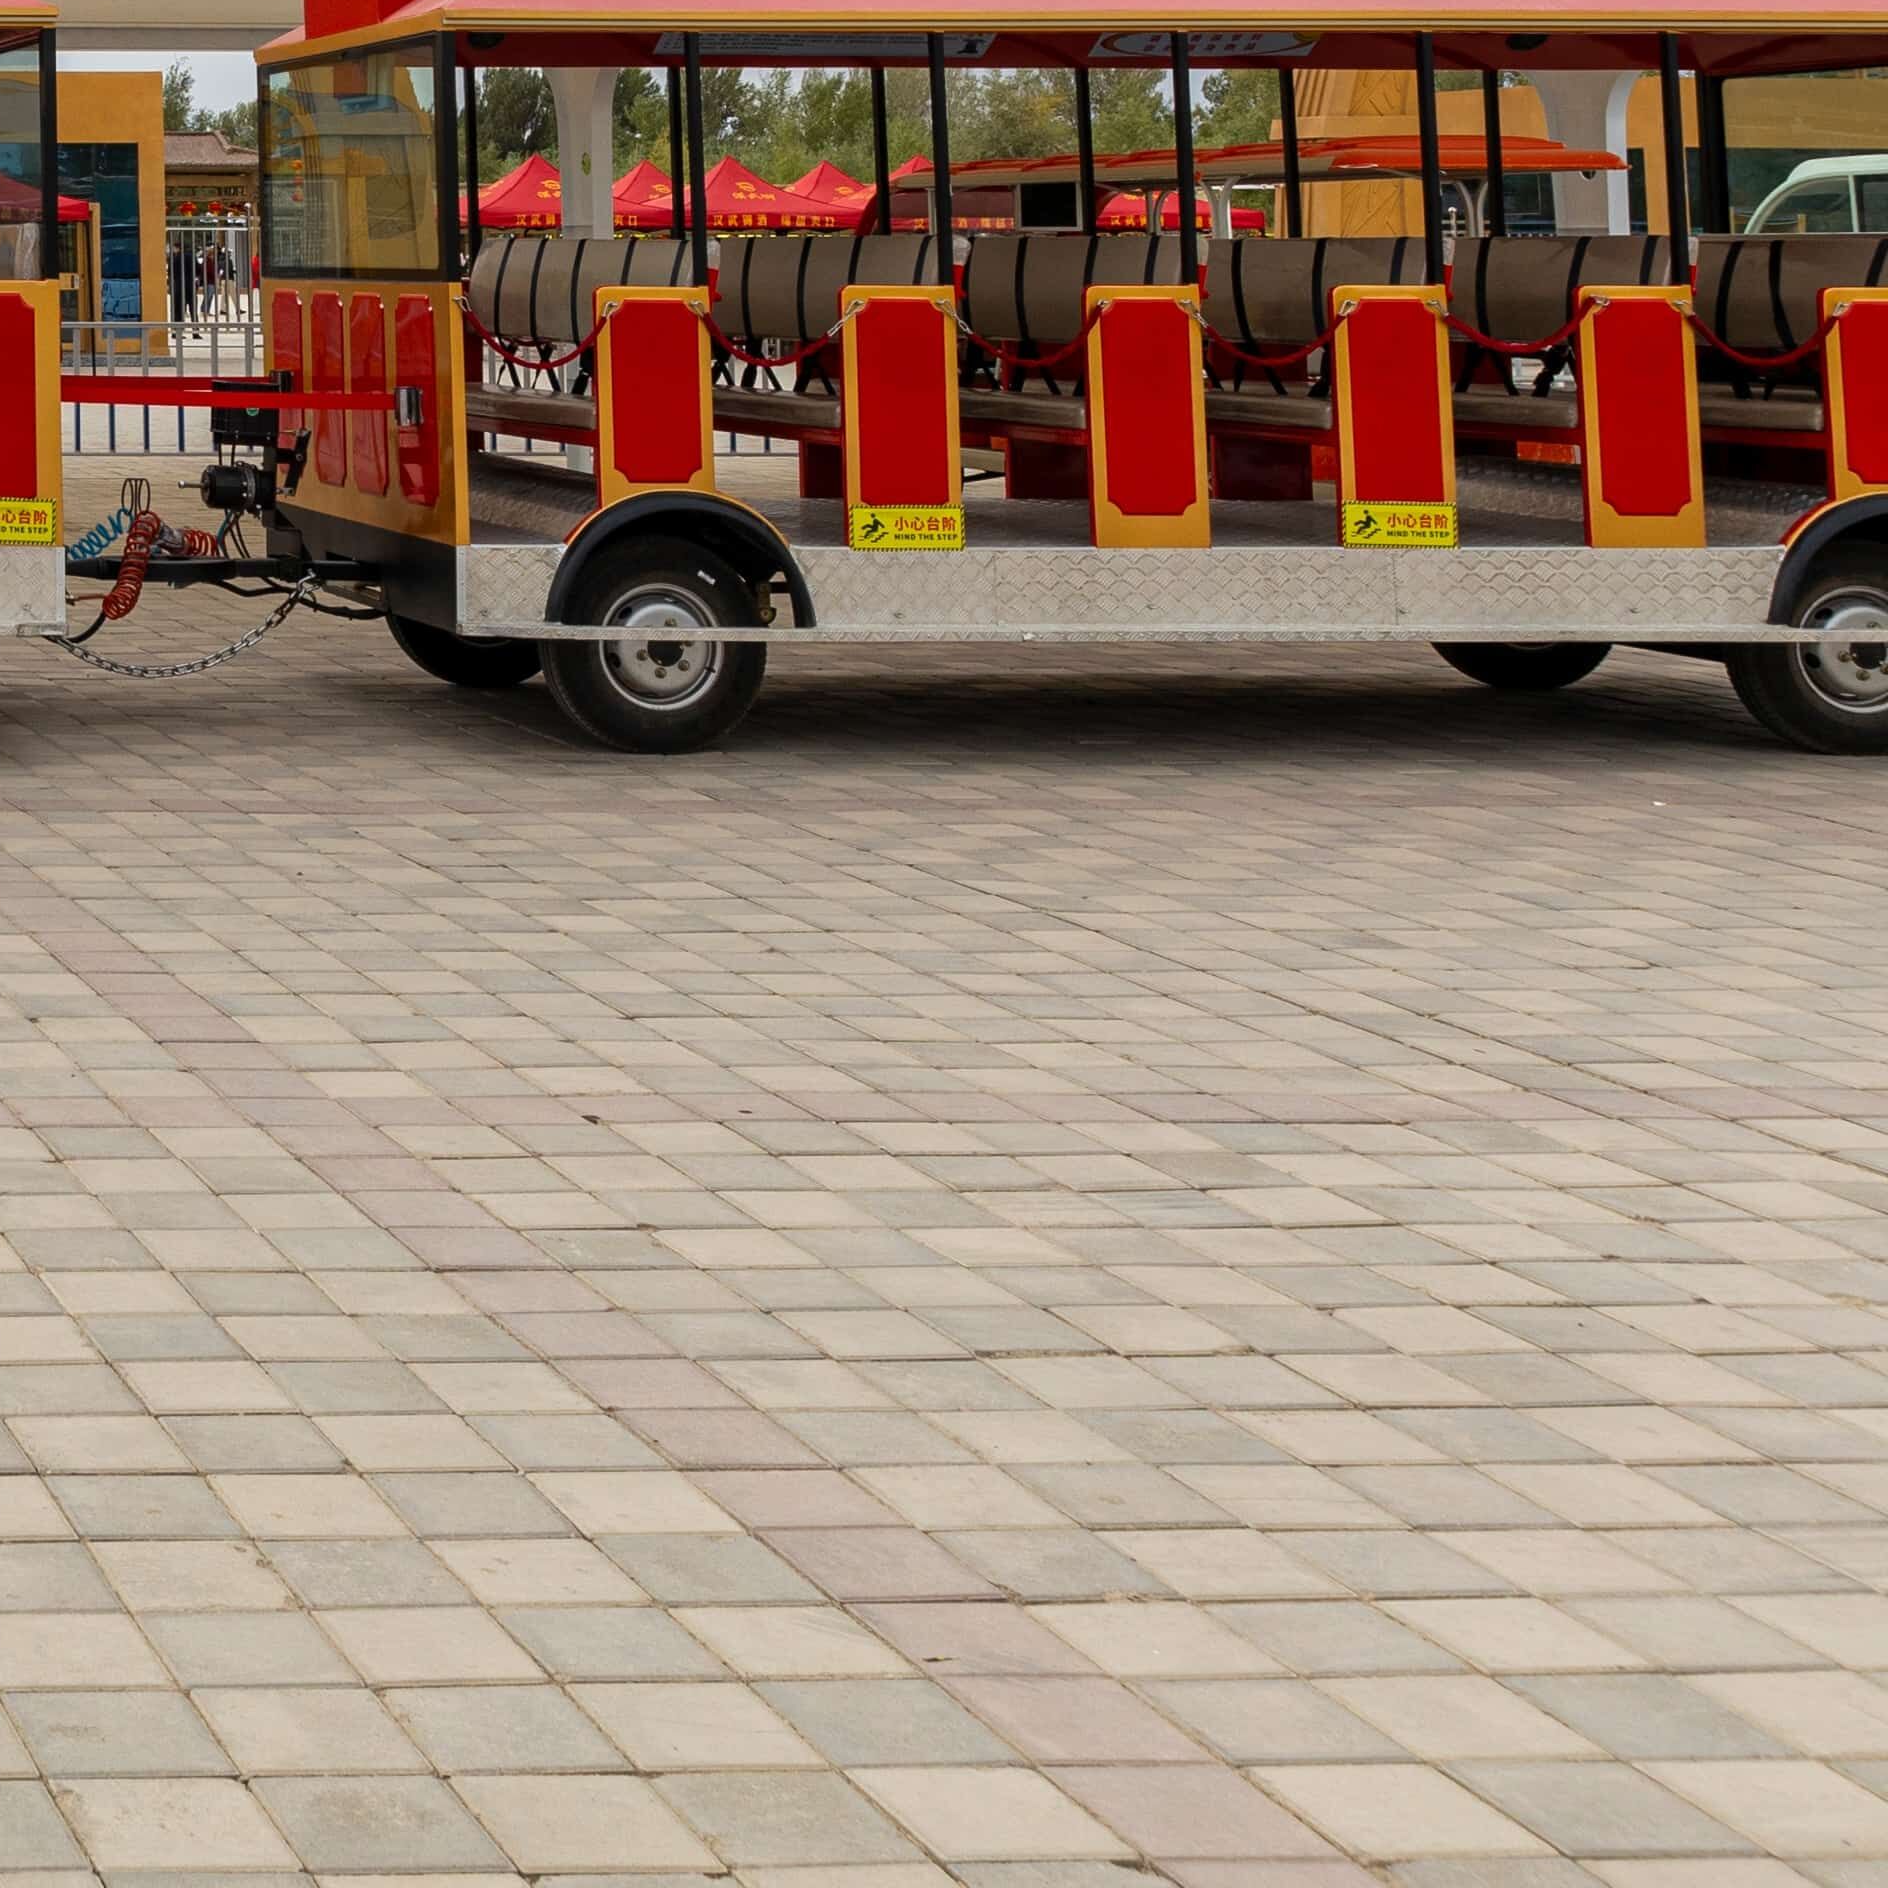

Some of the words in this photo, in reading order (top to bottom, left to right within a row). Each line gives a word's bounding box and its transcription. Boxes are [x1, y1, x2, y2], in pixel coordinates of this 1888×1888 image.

[894, 516, 956, 532] 小心台阶
[1387, 513, 1449, 529] 小心台阶
[27, 526, 48, 534] STEP
[1411, 530, 1427, 538] THE
[894, 533, 916, 541] MIND
